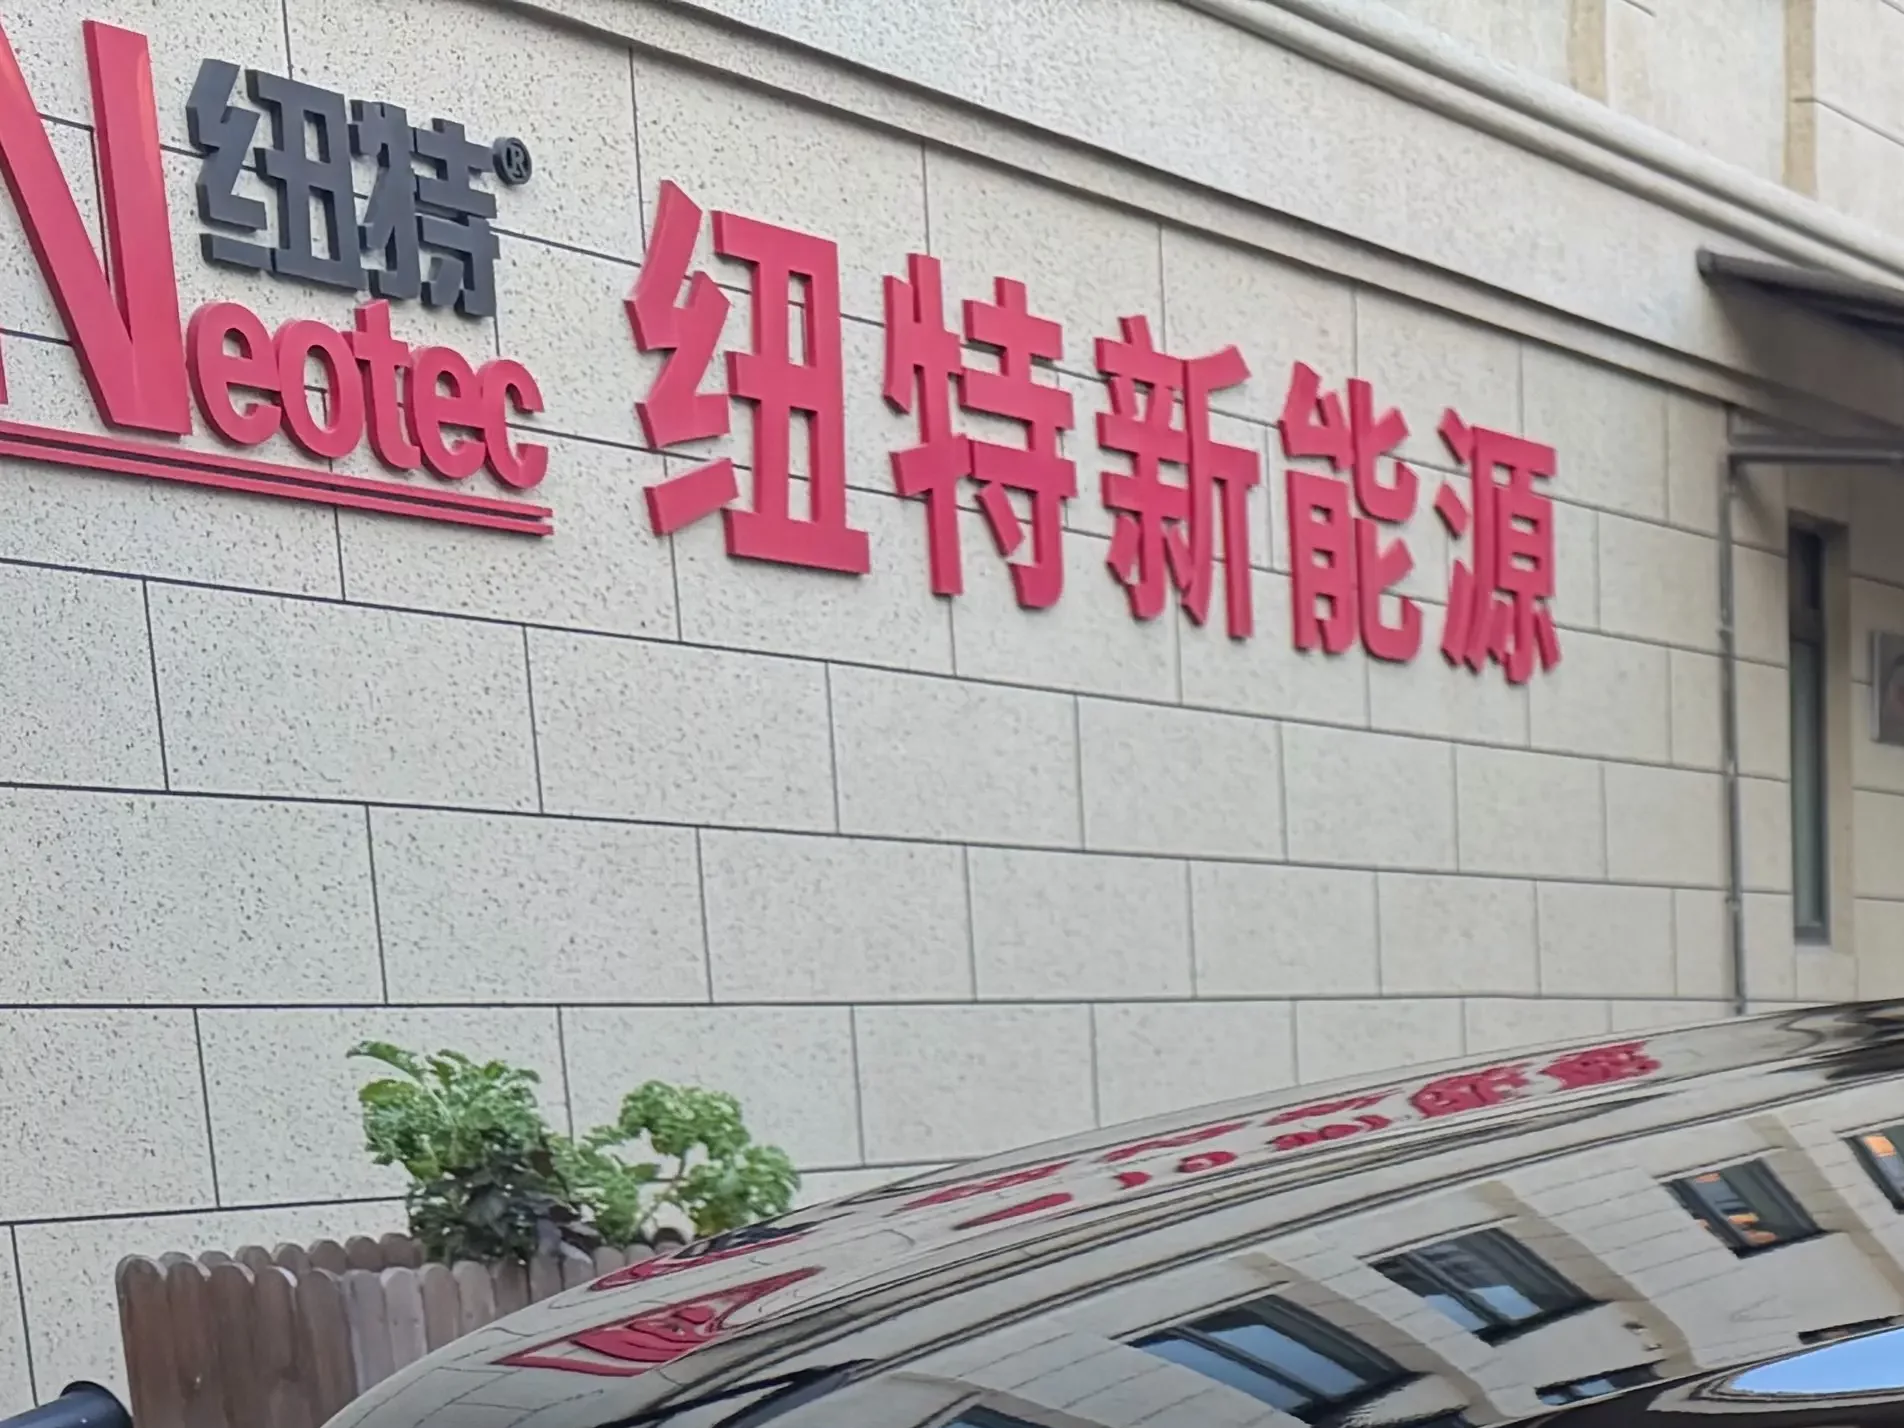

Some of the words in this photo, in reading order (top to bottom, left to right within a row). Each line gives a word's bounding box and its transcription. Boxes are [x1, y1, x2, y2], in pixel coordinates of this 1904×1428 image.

[0, 19, 549, 489] Neotec
[623, 178, 1562, 686] 纽特新能源
